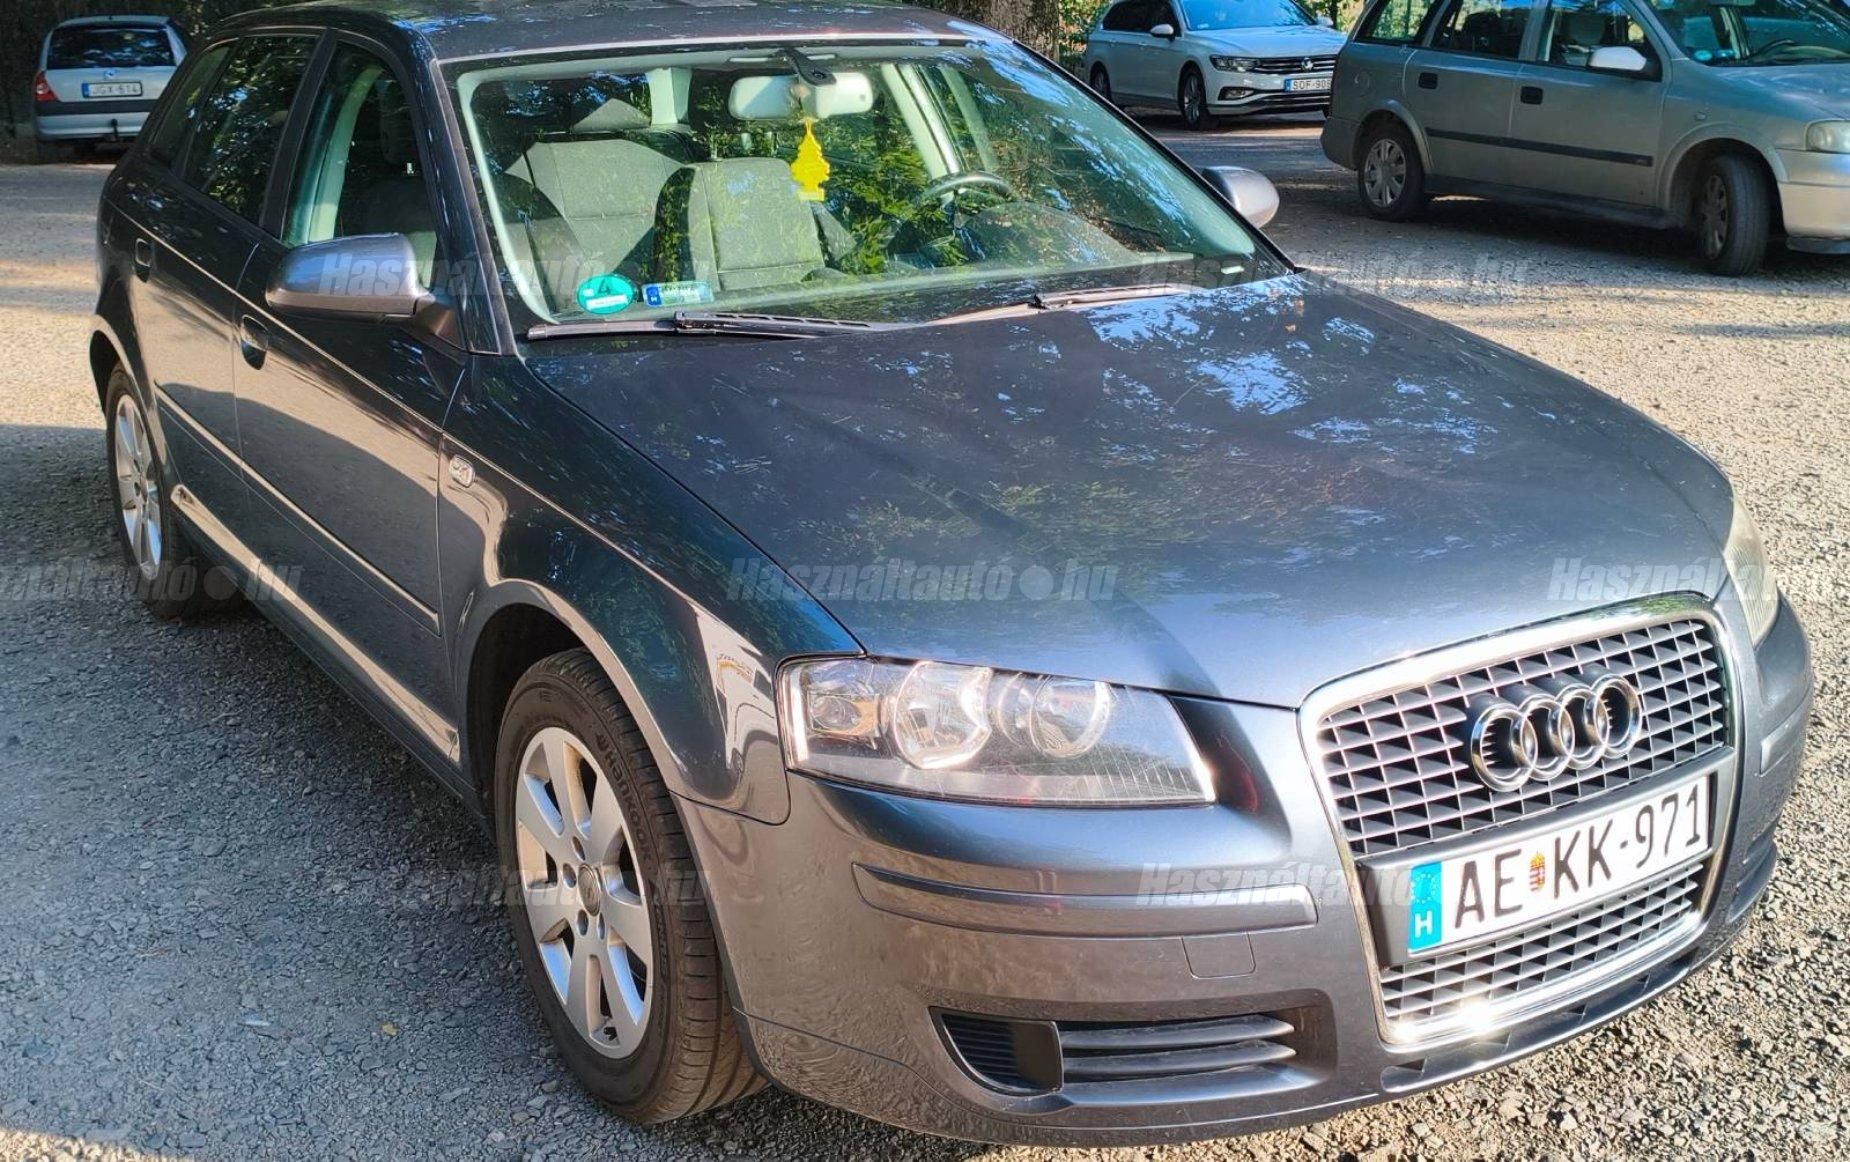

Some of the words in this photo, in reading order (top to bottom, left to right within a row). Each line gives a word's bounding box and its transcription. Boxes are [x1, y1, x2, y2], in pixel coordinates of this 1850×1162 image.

[1453, 848, 1522, 930] AE
[1552, 783, 1702, 900] KK-971
[1414, 910, 1432, 939] H
